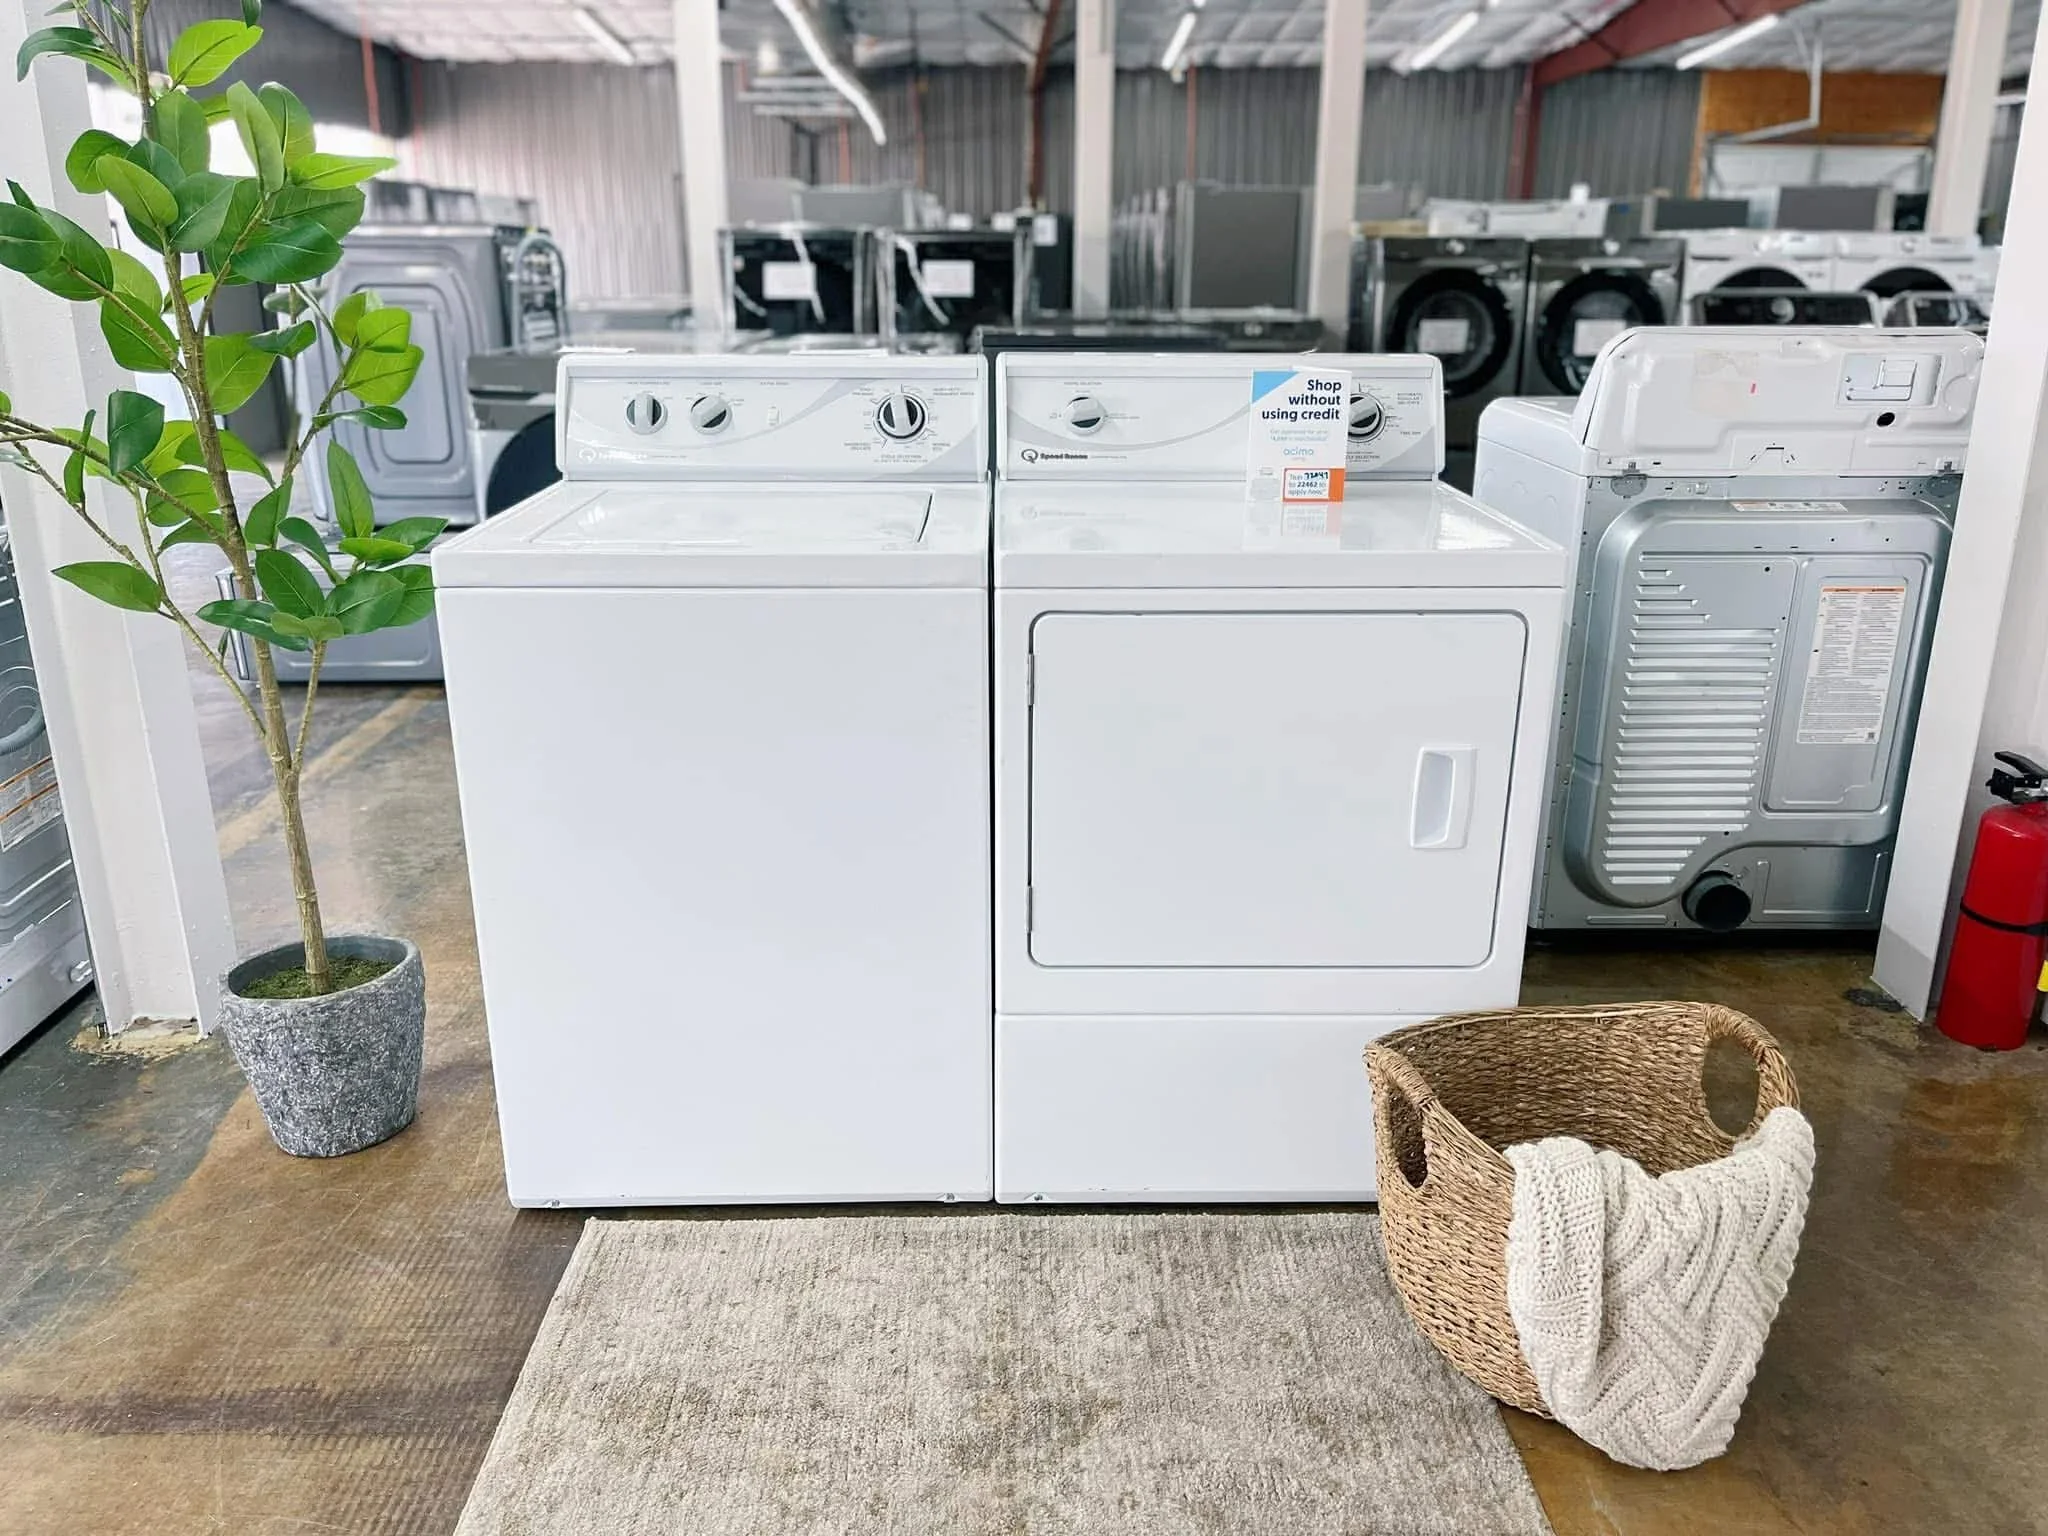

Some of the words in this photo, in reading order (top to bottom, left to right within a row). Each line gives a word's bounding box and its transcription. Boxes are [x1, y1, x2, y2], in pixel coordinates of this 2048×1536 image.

[1307, 379, 1342, 394] Shop
[1288, 393, 1341, 405] without
[1262, 407, 1298, 422] using
[1301, 407, 1340, 420] credit
[1283, 446, 1314, 456] acima
